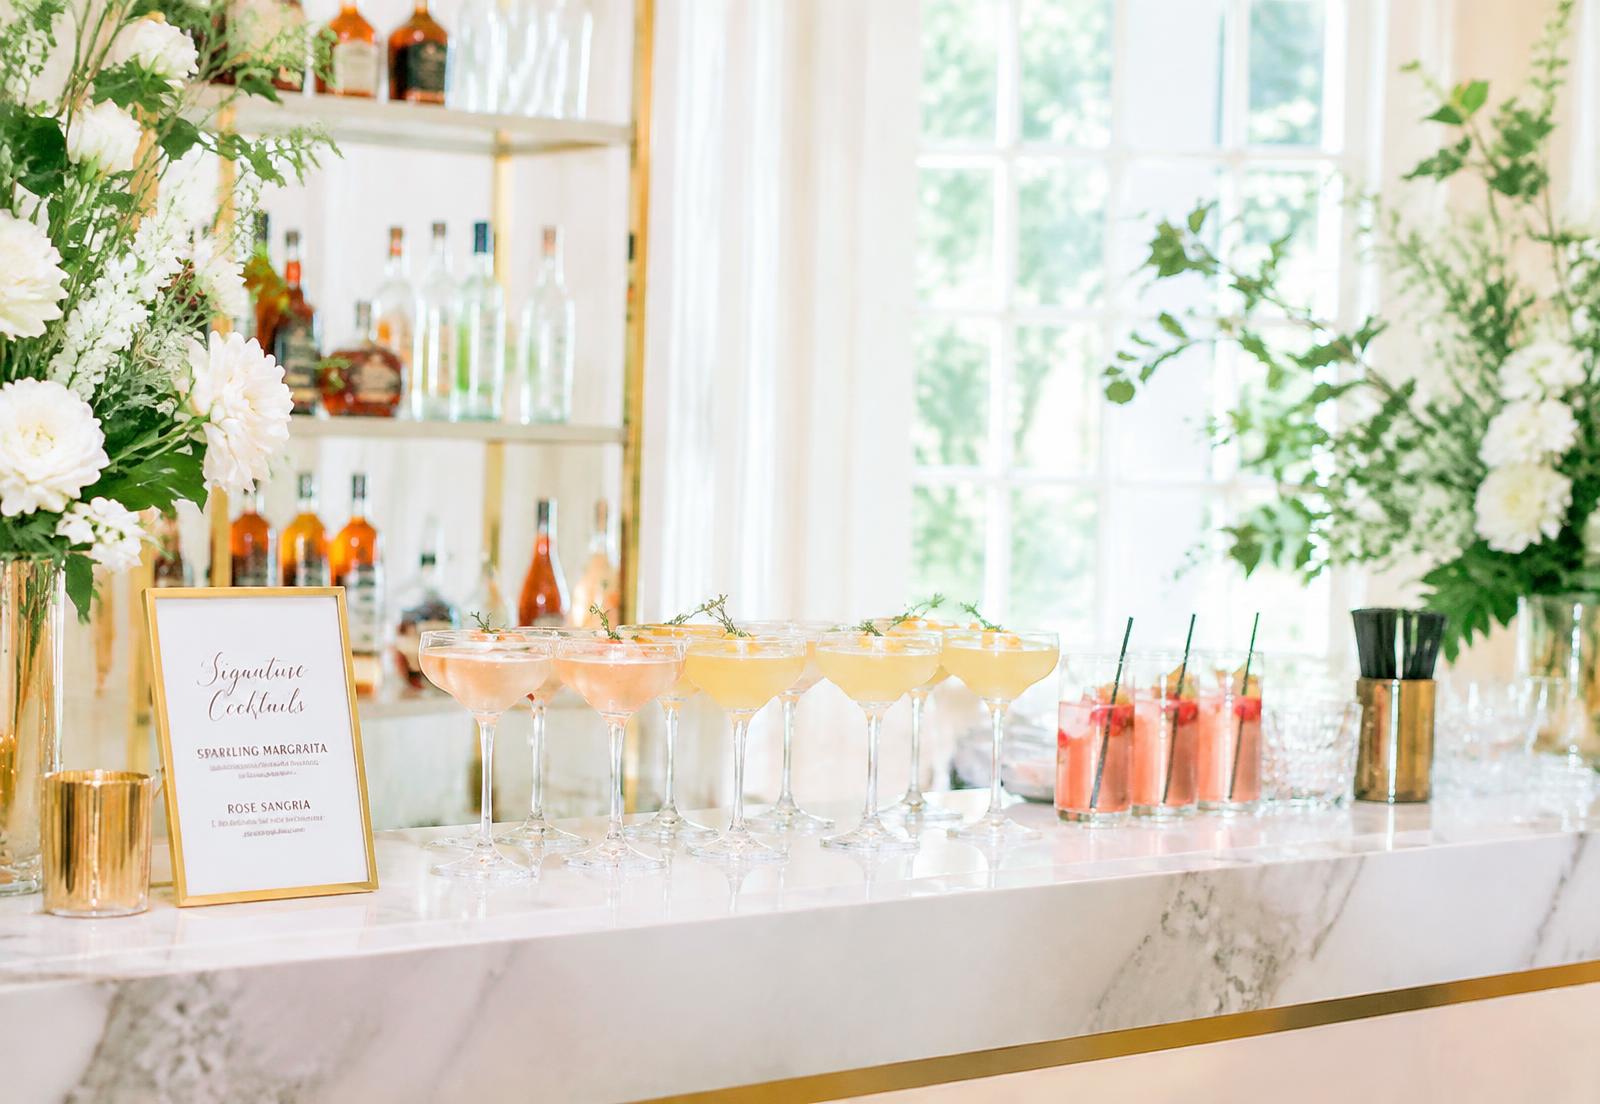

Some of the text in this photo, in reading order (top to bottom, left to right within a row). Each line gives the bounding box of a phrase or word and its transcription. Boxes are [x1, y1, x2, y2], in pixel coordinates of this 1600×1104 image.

[197, 651, 307, 696] Signature
[208, 687, 305, 722] Cocktails
[228, 800, 311, 815] ROSE SANGRIA
